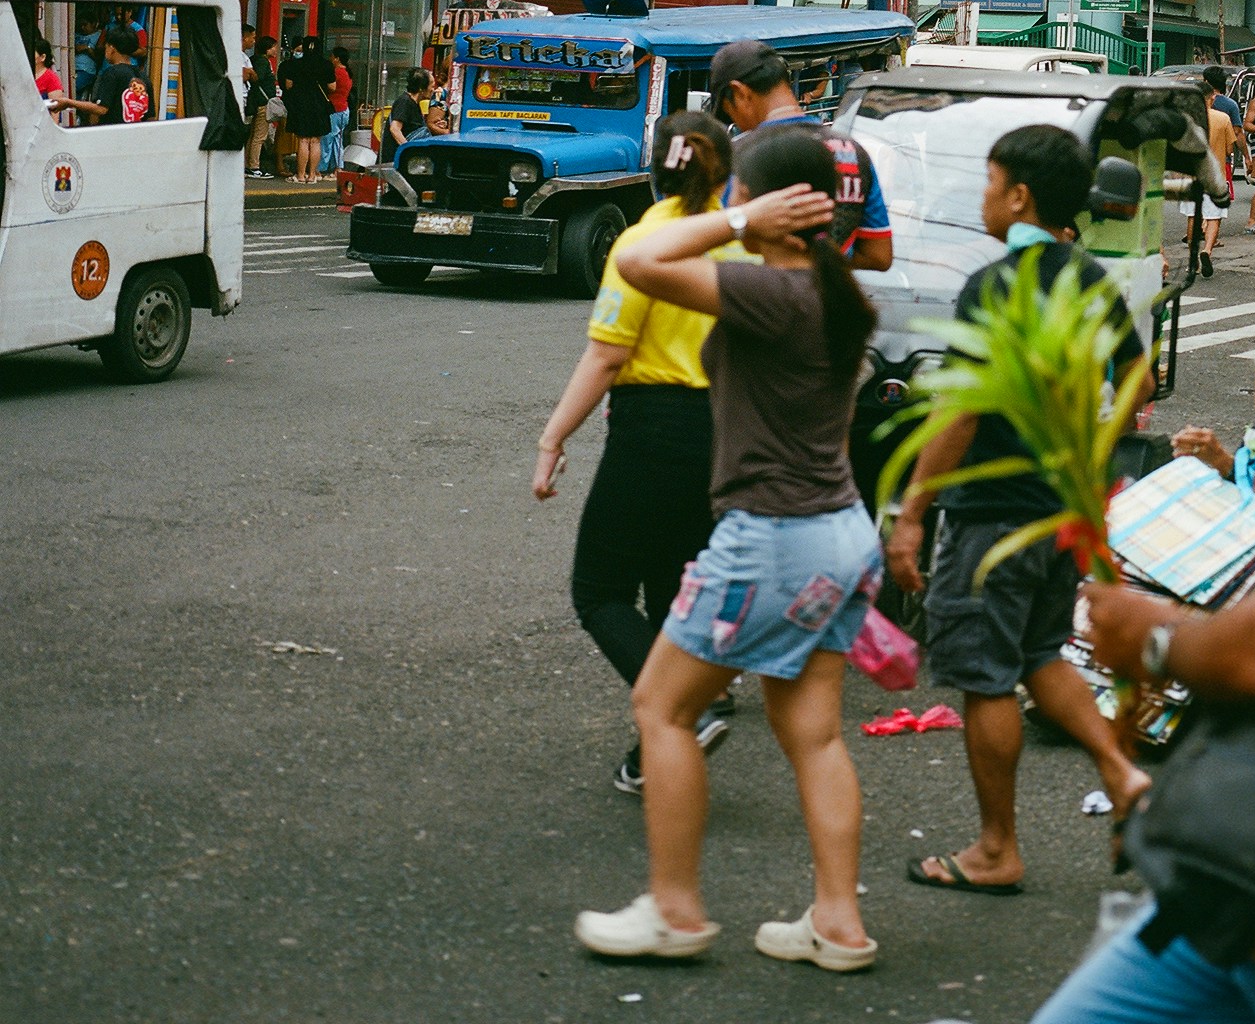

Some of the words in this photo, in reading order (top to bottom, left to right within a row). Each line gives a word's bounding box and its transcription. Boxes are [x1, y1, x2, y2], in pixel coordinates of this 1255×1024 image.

[464, 34, 627, 69] Ericka
[500, 111, 514, 119] TAFT
[516, 112, 548, 120] BACLARAN
